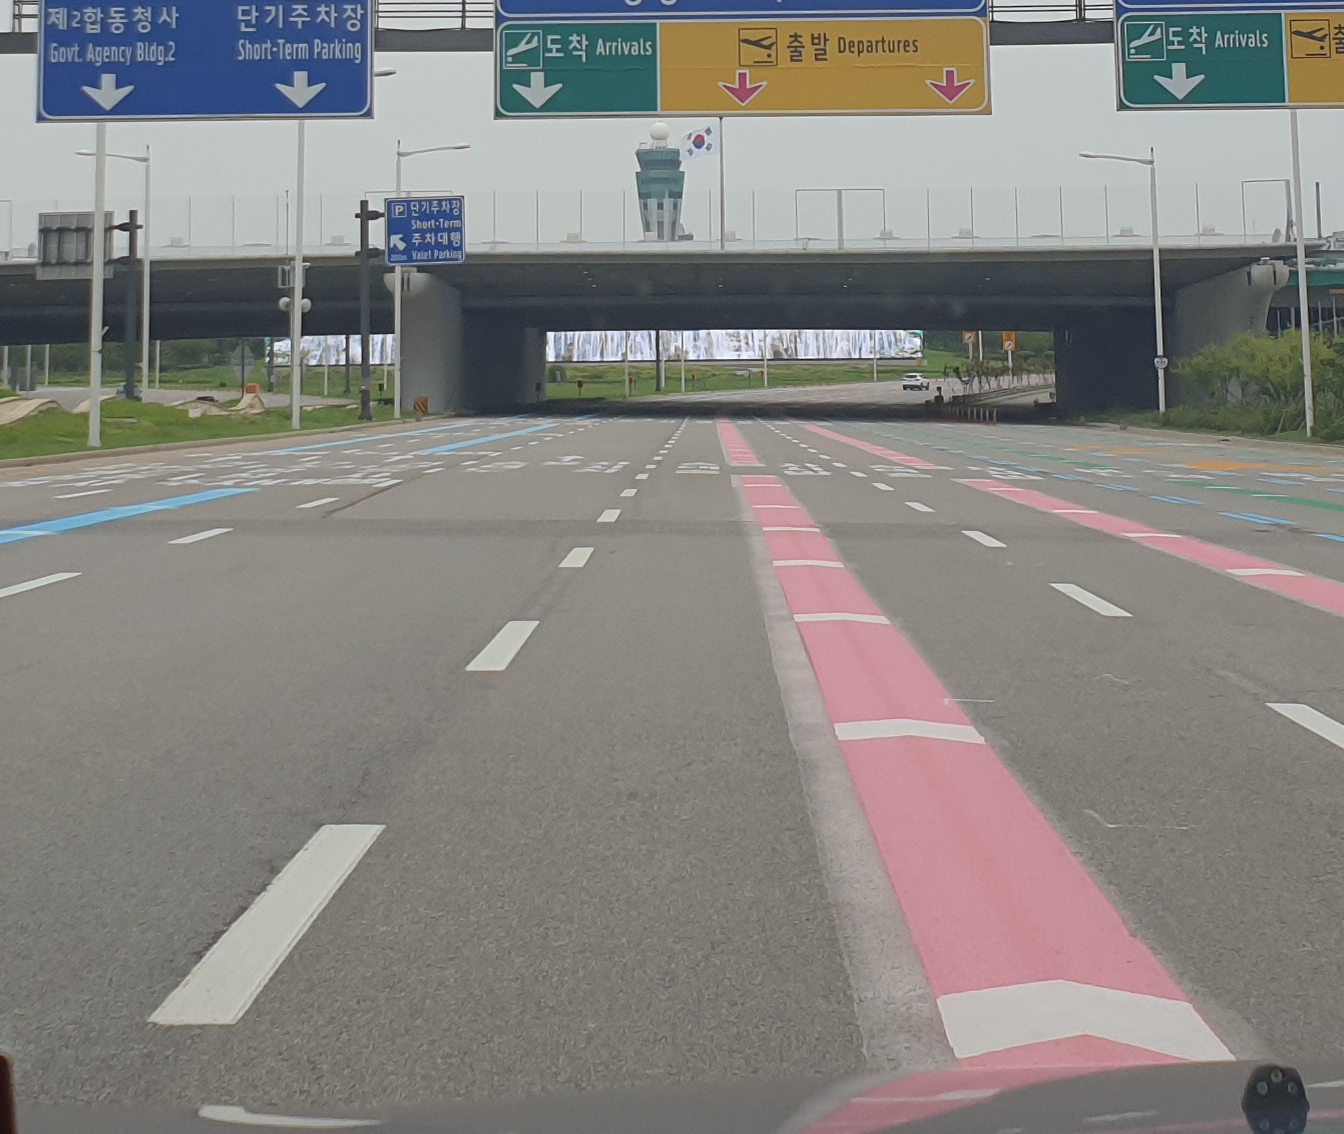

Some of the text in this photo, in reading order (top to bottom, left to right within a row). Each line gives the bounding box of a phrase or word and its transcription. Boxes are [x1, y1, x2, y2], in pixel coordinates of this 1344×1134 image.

[47, 6, 179, 34] 제2합동청사
[237, 4, 364, 33] 단기주차장
[49, 41, 176, 66] Govt. Agency Bldg.2
[237, 38, 363, 64] Short-Term Parking
[544, 33, 653, 63] 도착 Arrivals
[786, 32, 919, 63] 출발 Departures
[1167, 26, 1269, 55] 도착 Arrivals
[410, 200, 461, 216] 단기주차장
[411, 218, 461, 230] Short-Term
[411, 231, 461, 247] 주차대행
[433, 249, 462, 261] Parking
